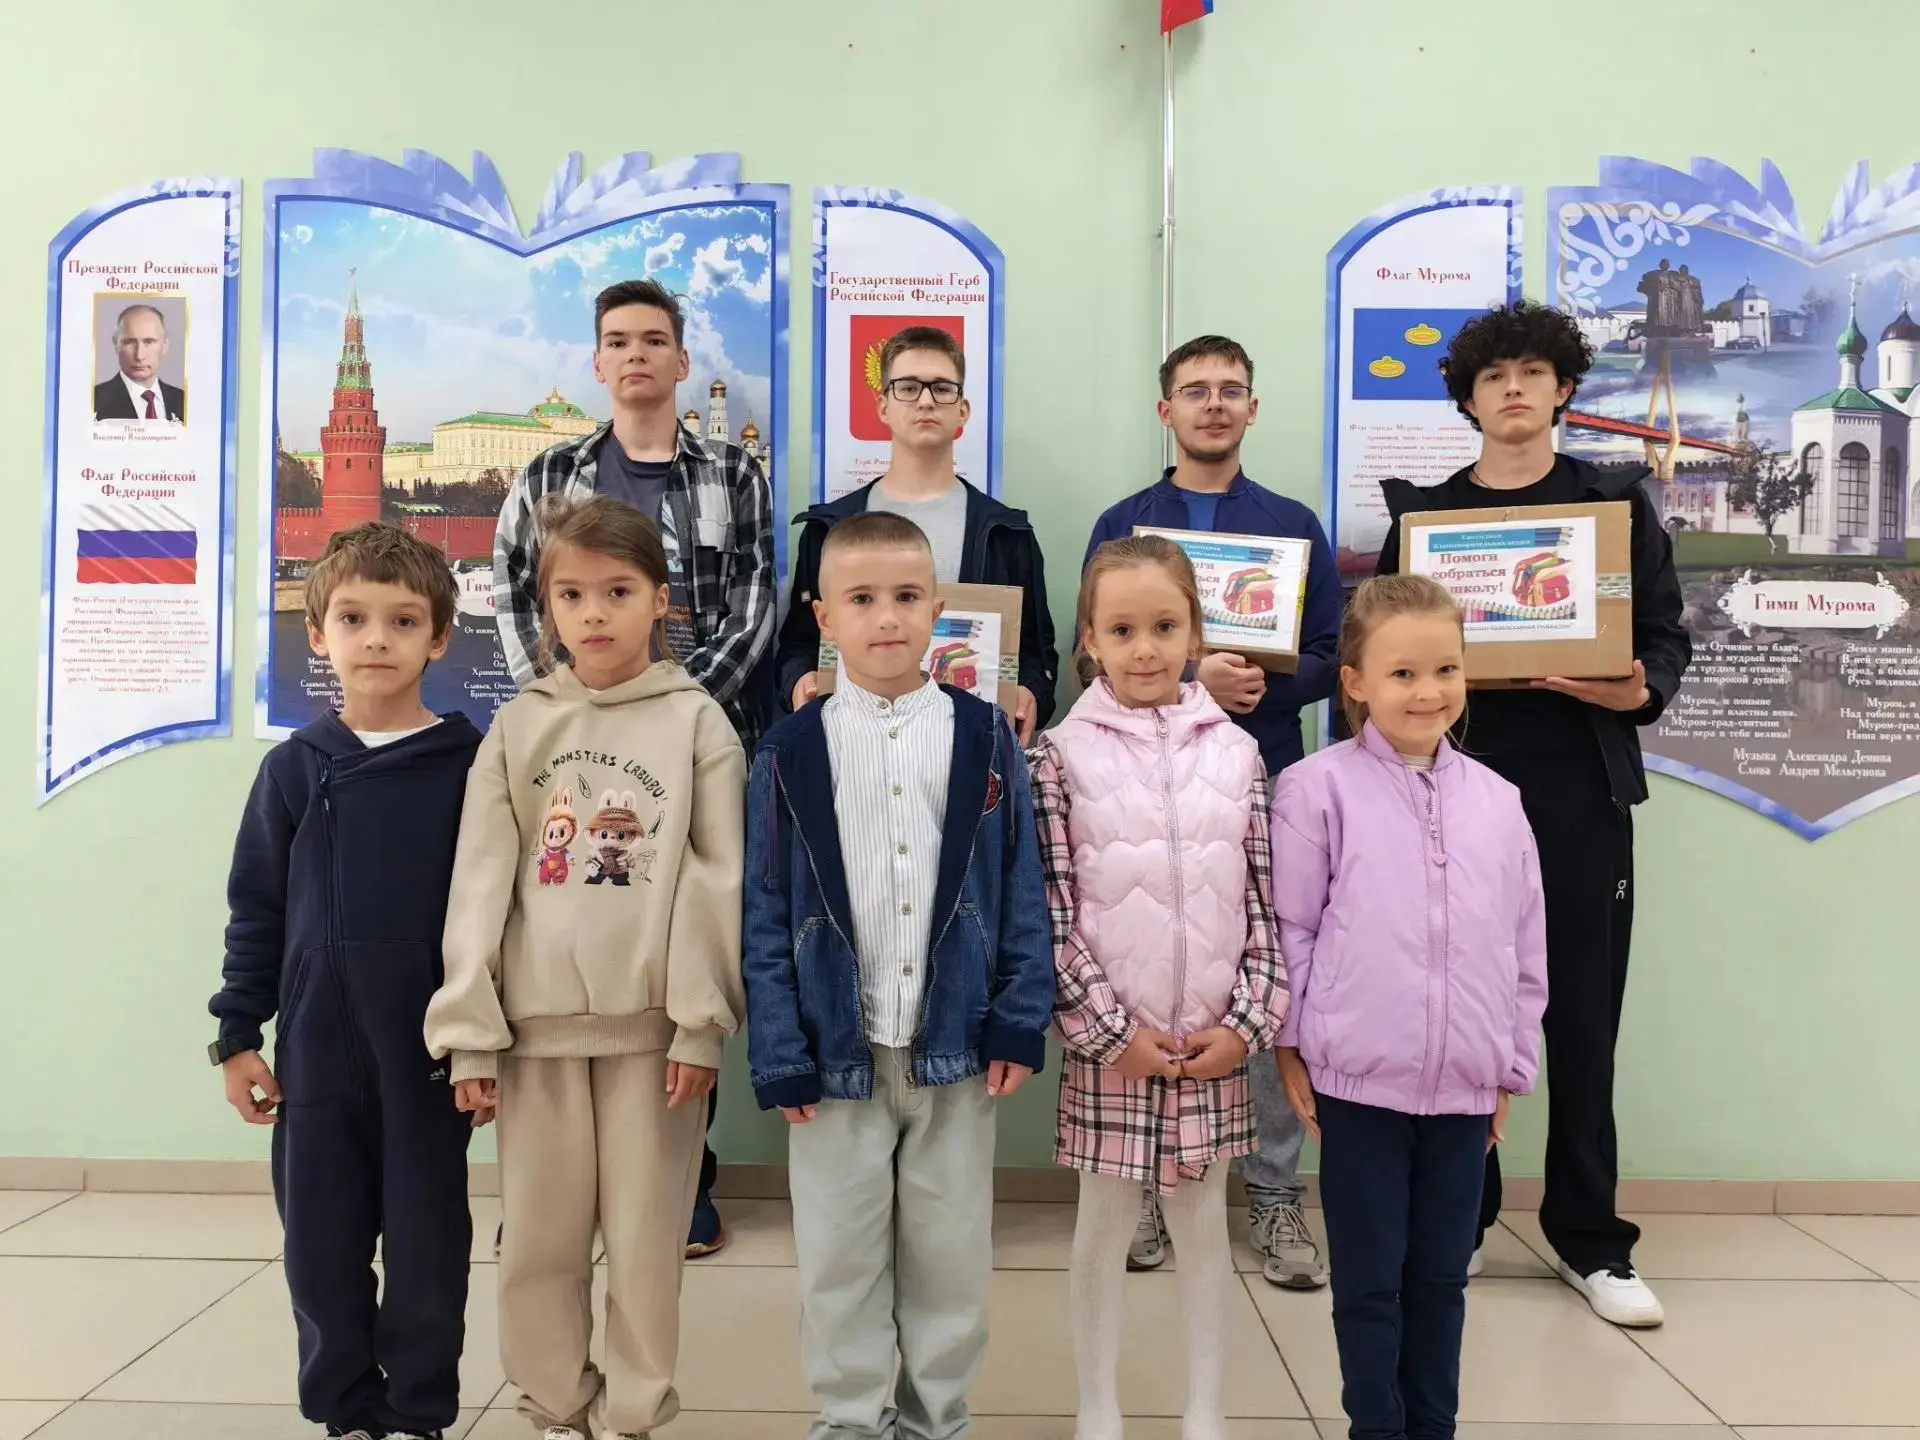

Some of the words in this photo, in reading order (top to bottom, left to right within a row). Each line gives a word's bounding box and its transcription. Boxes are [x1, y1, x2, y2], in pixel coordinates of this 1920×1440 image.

[68, 260, 138, 277] Президент
[143, 260, 219, 275] Российской
[830, 271, 944, 288] Государственный
[949, 272, 980, 289] Герб
[1376, 267, 1412, 280] Флаг
[1417, 267, 1471, 284] Мурома
[106, 276, 180, 293] Федерации
[830, 288, 906, 302] Российской
[911, 288, 985, 305] Федерации
[81, 467, 115, 481] Флаг
[121, 467, 196, 482] Российской
[101, 483, 175, 500] Федерации
[1440, 552, 1499, 564] Помоги
[1193, 562, 1215, 570] оги
[1432, 567, 1507, 581] собраться
[466, 578, 493, 592] Гим
[1451, 582, 1504, 595] школу!
[1754, 593, 1798, 611] Гимн
[1807, 593, 1876, 615] Мурома
[1709, 641, 1752, 652] Отчизне
[1846, 642, 1878, 653] Земле
[1881, 644, 1913, 654] нашей
[1725, 653, 1765, 664] мудрый
[1842, 653, 1850, 664] В
[1853, 655, 1871, 664] ней
[1701, 665, 1735, 674] трудом
[1703, 674, 1748, 686] широкой
[1847, 675, 1872, 687] Русь
[1678, 706, 1709, 716] тобою
[1712, 708, 1724, 716] не
[1728, 709, 1769, 717] властны
[1840, 707, 1862, 718] Над
[1865, 709, 1896, 719] тобою
[1858, 718, 1920, 731] Муром-град
[1658, 726, 1689, 737] Наша
[1692, 730, 1716, 739] вера
[1729, 729, 1750, 738] тебя
[1846, 729, 1876, 740] Наша
[1879, 732, 1902, 742] вера
[1733, 747, 1777, 765] Музыка
[1785, 748, 1848, 765] Александра
[1851, 749, 1892, 765] Демина
[1738, 762, 1771, 775] Слова
[1779, 763, 1820, 779] Андрея
[1824, 763, 1887, 780] Мельгунова
[532, 768, 552, 788] THE
